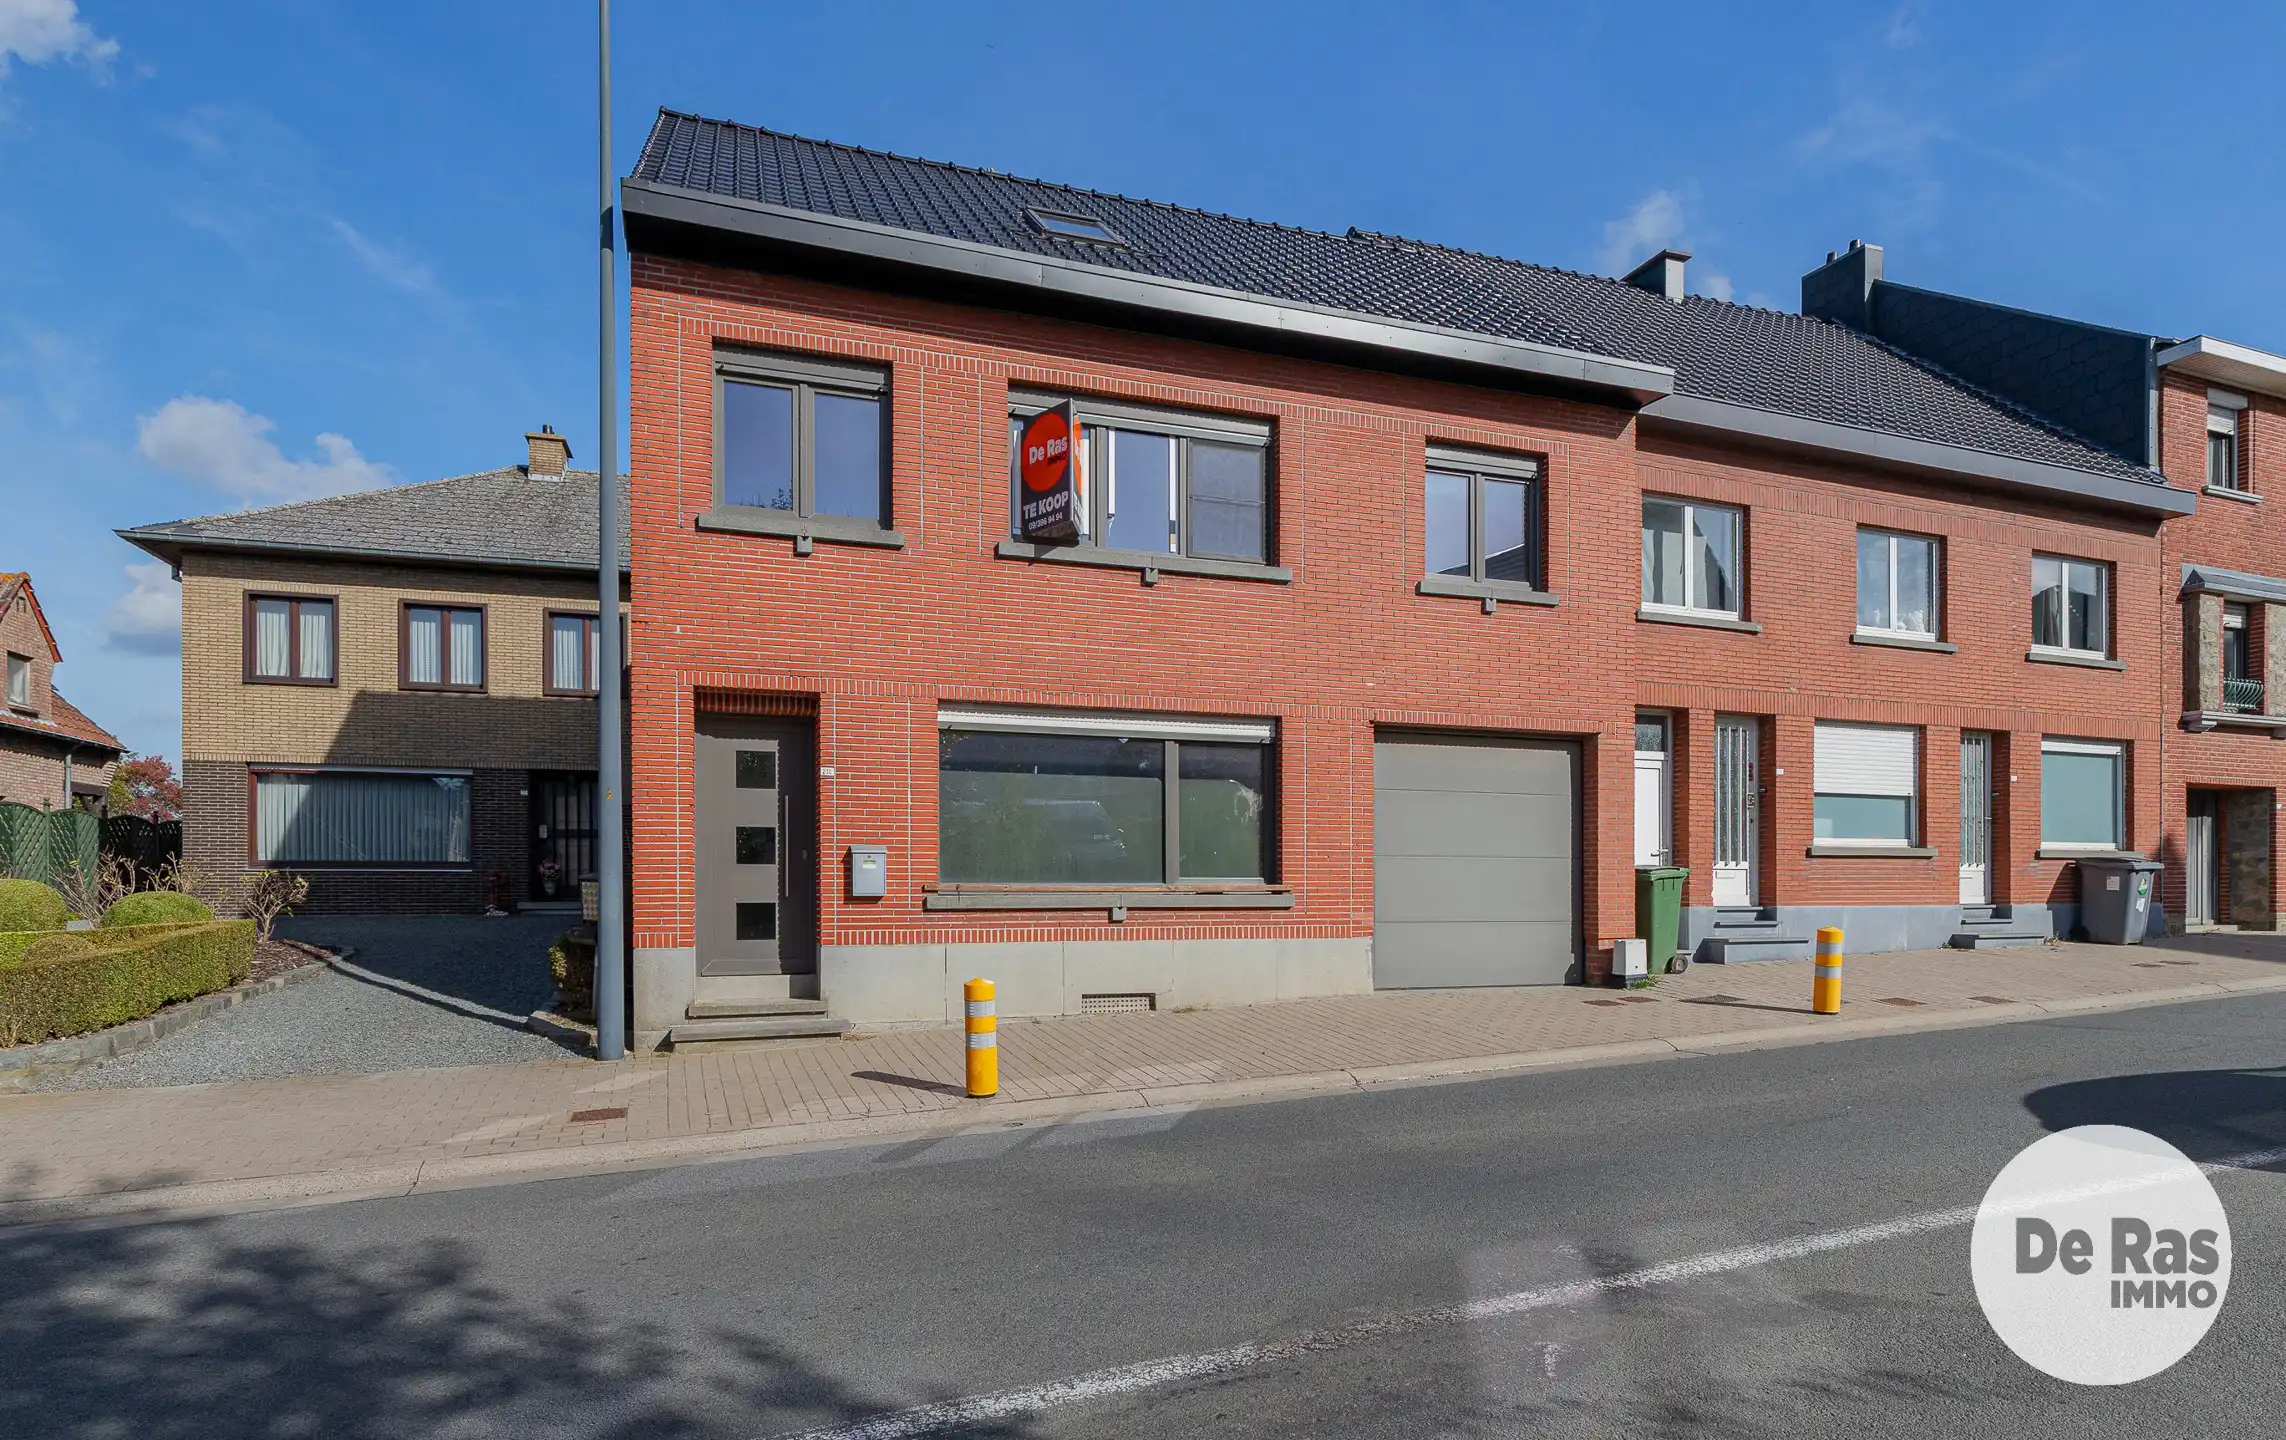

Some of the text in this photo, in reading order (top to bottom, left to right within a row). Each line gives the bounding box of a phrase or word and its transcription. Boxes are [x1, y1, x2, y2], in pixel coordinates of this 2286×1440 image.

[1029, 446, 1044, 465] De
[1047, 436, 1068, 457] Ras
[1023, 502, 1037, 520] TE
[1039, 491, 1069, 515] KOOP
